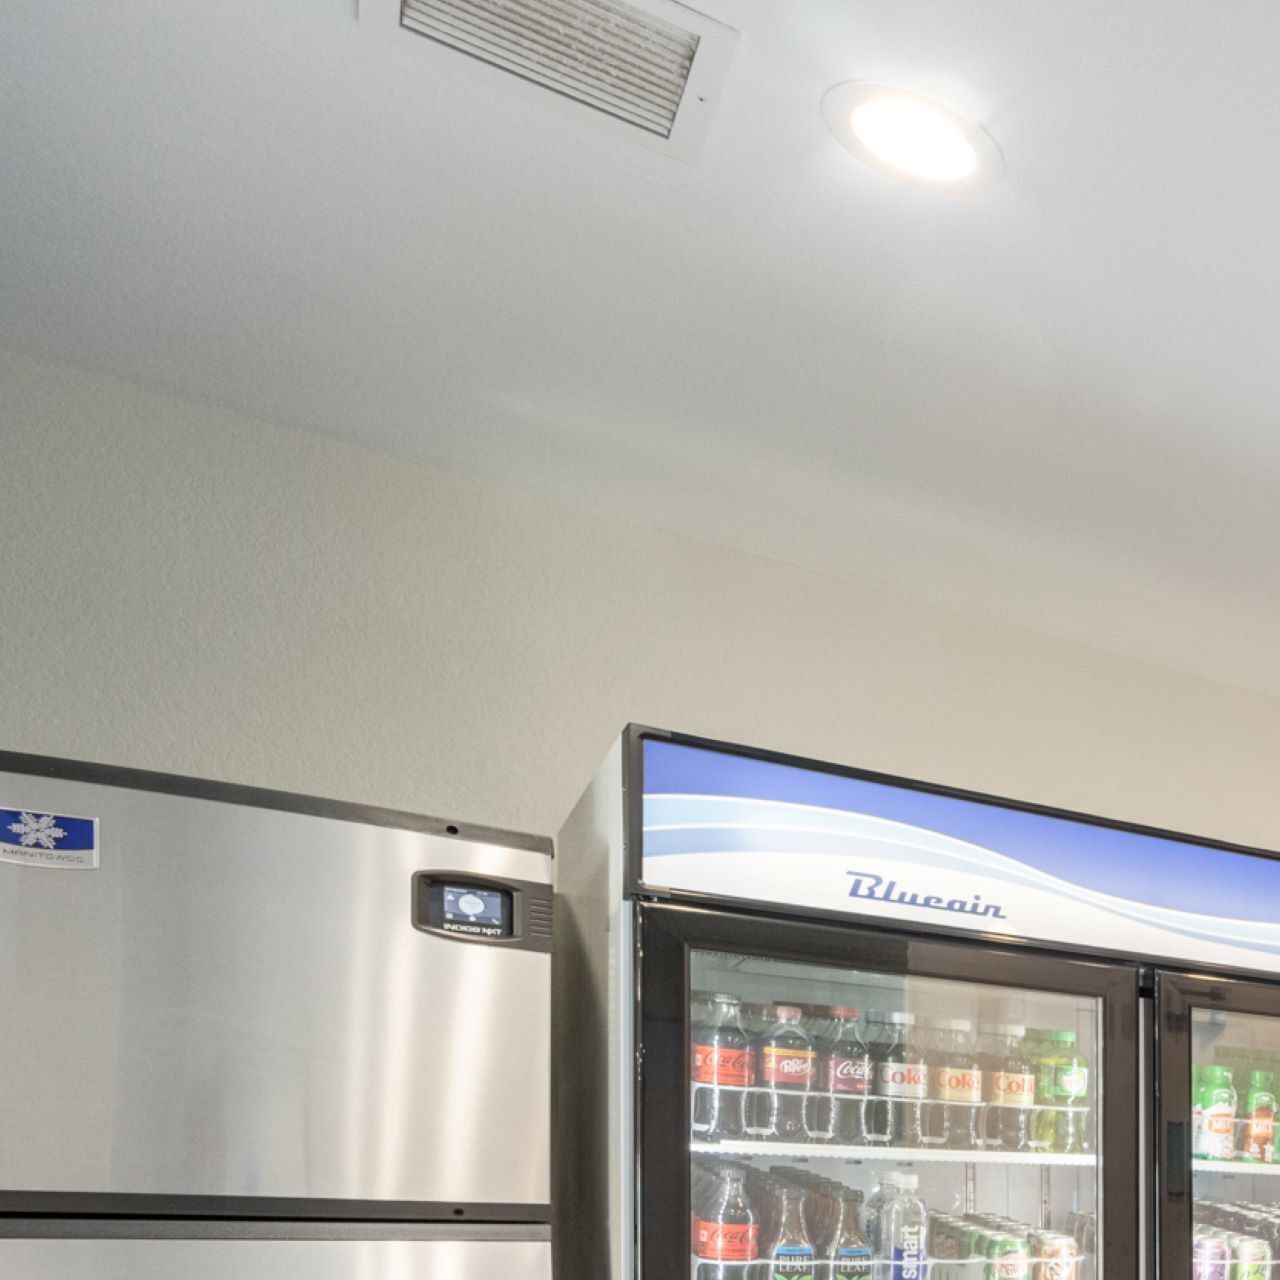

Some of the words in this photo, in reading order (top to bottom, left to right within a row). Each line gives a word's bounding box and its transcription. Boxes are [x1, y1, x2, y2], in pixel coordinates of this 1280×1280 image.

[3, 848, 85, 864] MANITOWOC
[846, 871, 1007, 919] Blueair
[443, 923, 481, 933] INDIGO
[879, 1066, 928, 1085] Coke
[936, 1069, 982, 1089] Coke
[902, 1225, 919, 1279] smart
[780, 1264, 809, 1272] LEAF
[841, 1264, 868, 1272] LEAF
